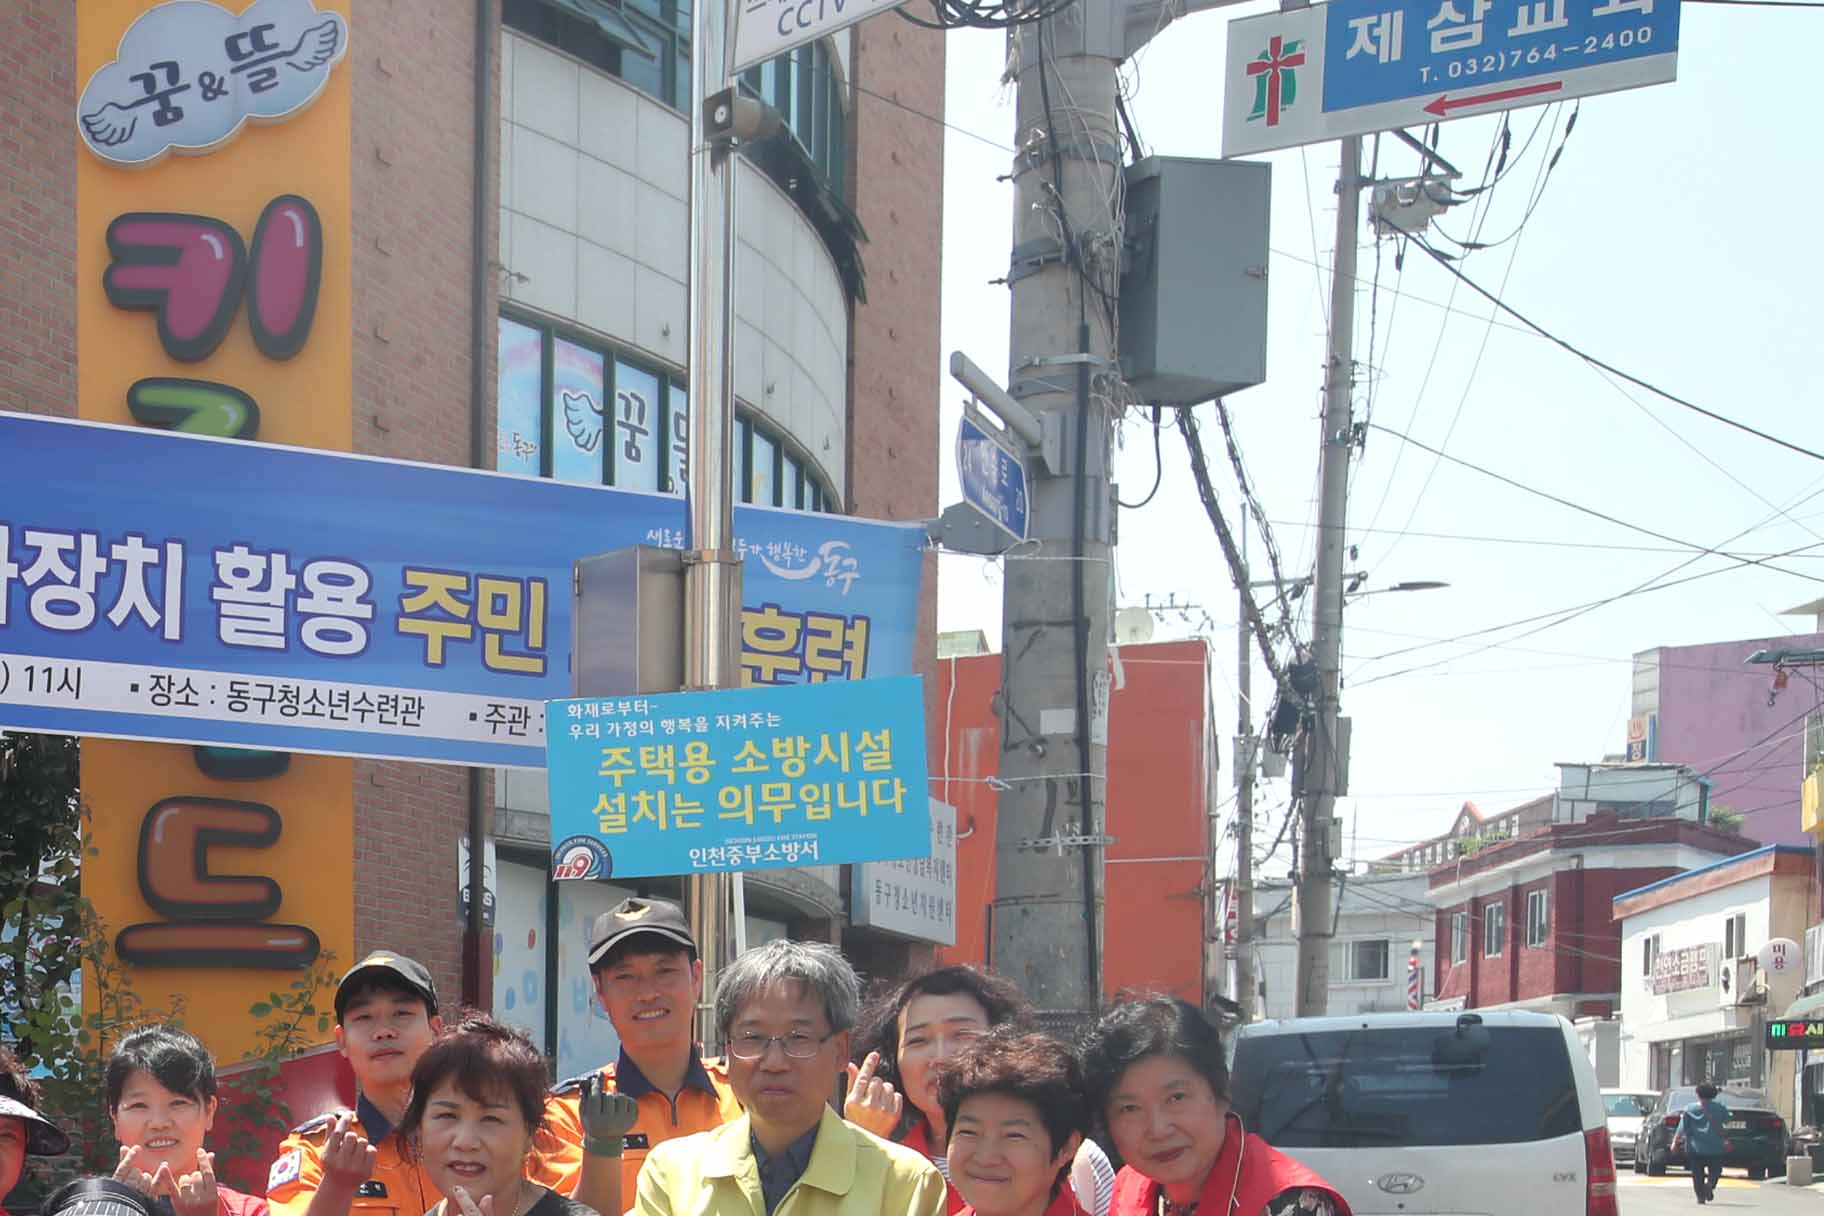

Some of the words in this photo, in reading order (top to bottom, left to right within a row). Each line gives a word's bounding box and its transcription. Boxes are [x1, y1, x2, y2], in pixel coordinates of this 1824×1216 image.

[1448, 26, 1653, 79] 032)764-2400
[212, 544, 373, 656] 활용
[397, 568, 546, 673] 주민
[23, 664, 82, 699] 11시
[148, 672, 200, 709] 장소
[226, 680, 425, 729] 동구청소년수련관
[483, 702, 532, 737] 주관
[568, 723, 600, 740] 우리
[607, 719, 655, 738] 가정의
[660, 715, 710, 735] 행복을
[715, 711, 782, 731] 지켜주는
[597, 740, 717, 788] 주택용
[730, 727, 895, 778] 소방시설
[591, 789, 705, 834] 설치는
[717, 777, 908, 826] 의무입니다
[688, 840, 820, 868] 인천중부소방서
